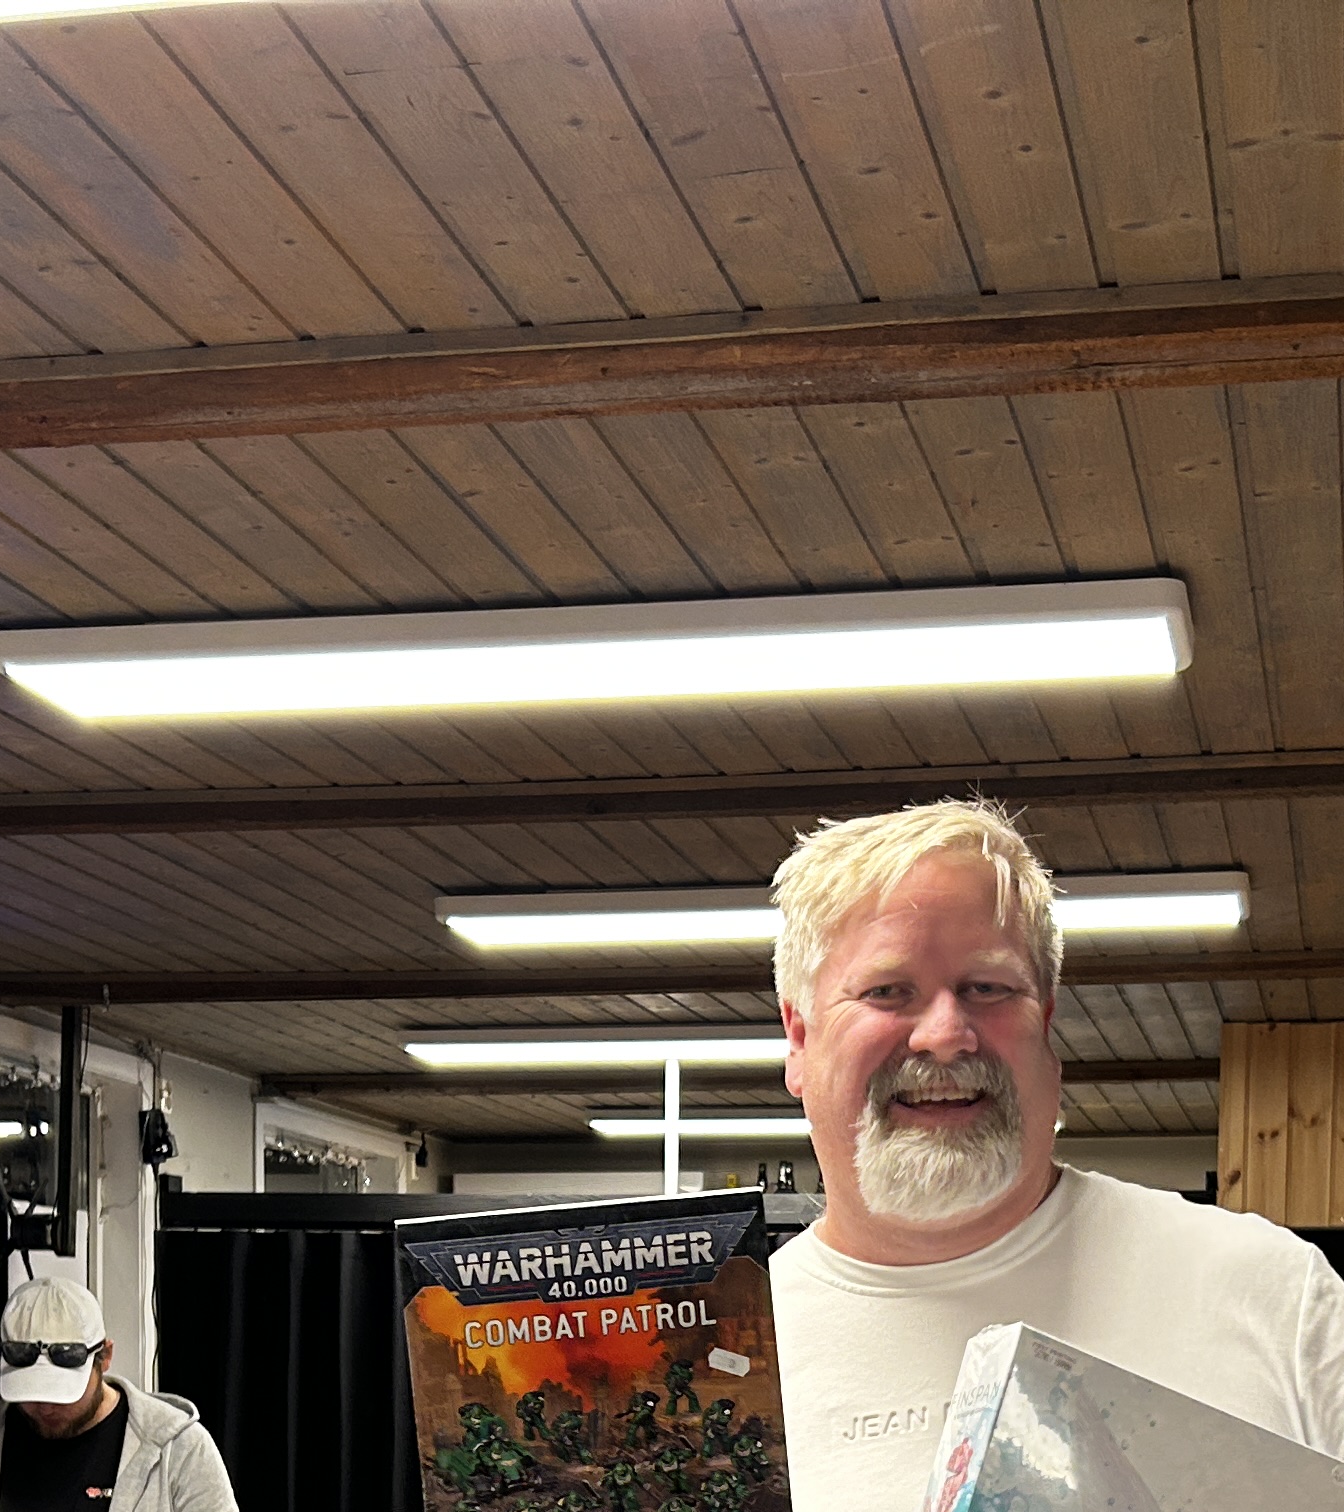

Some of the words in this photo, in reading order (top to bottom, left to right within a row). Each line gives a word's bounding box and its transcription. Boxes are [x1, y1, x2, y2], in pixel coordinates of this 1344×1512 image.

[453, 1230, 715, 1287] WARHAMMER
[464, 1311, 588, 1349] COMBAT
[600, 1299, 717, 1336] PATROL
[842, 1405, 929, 1442] JEAN
